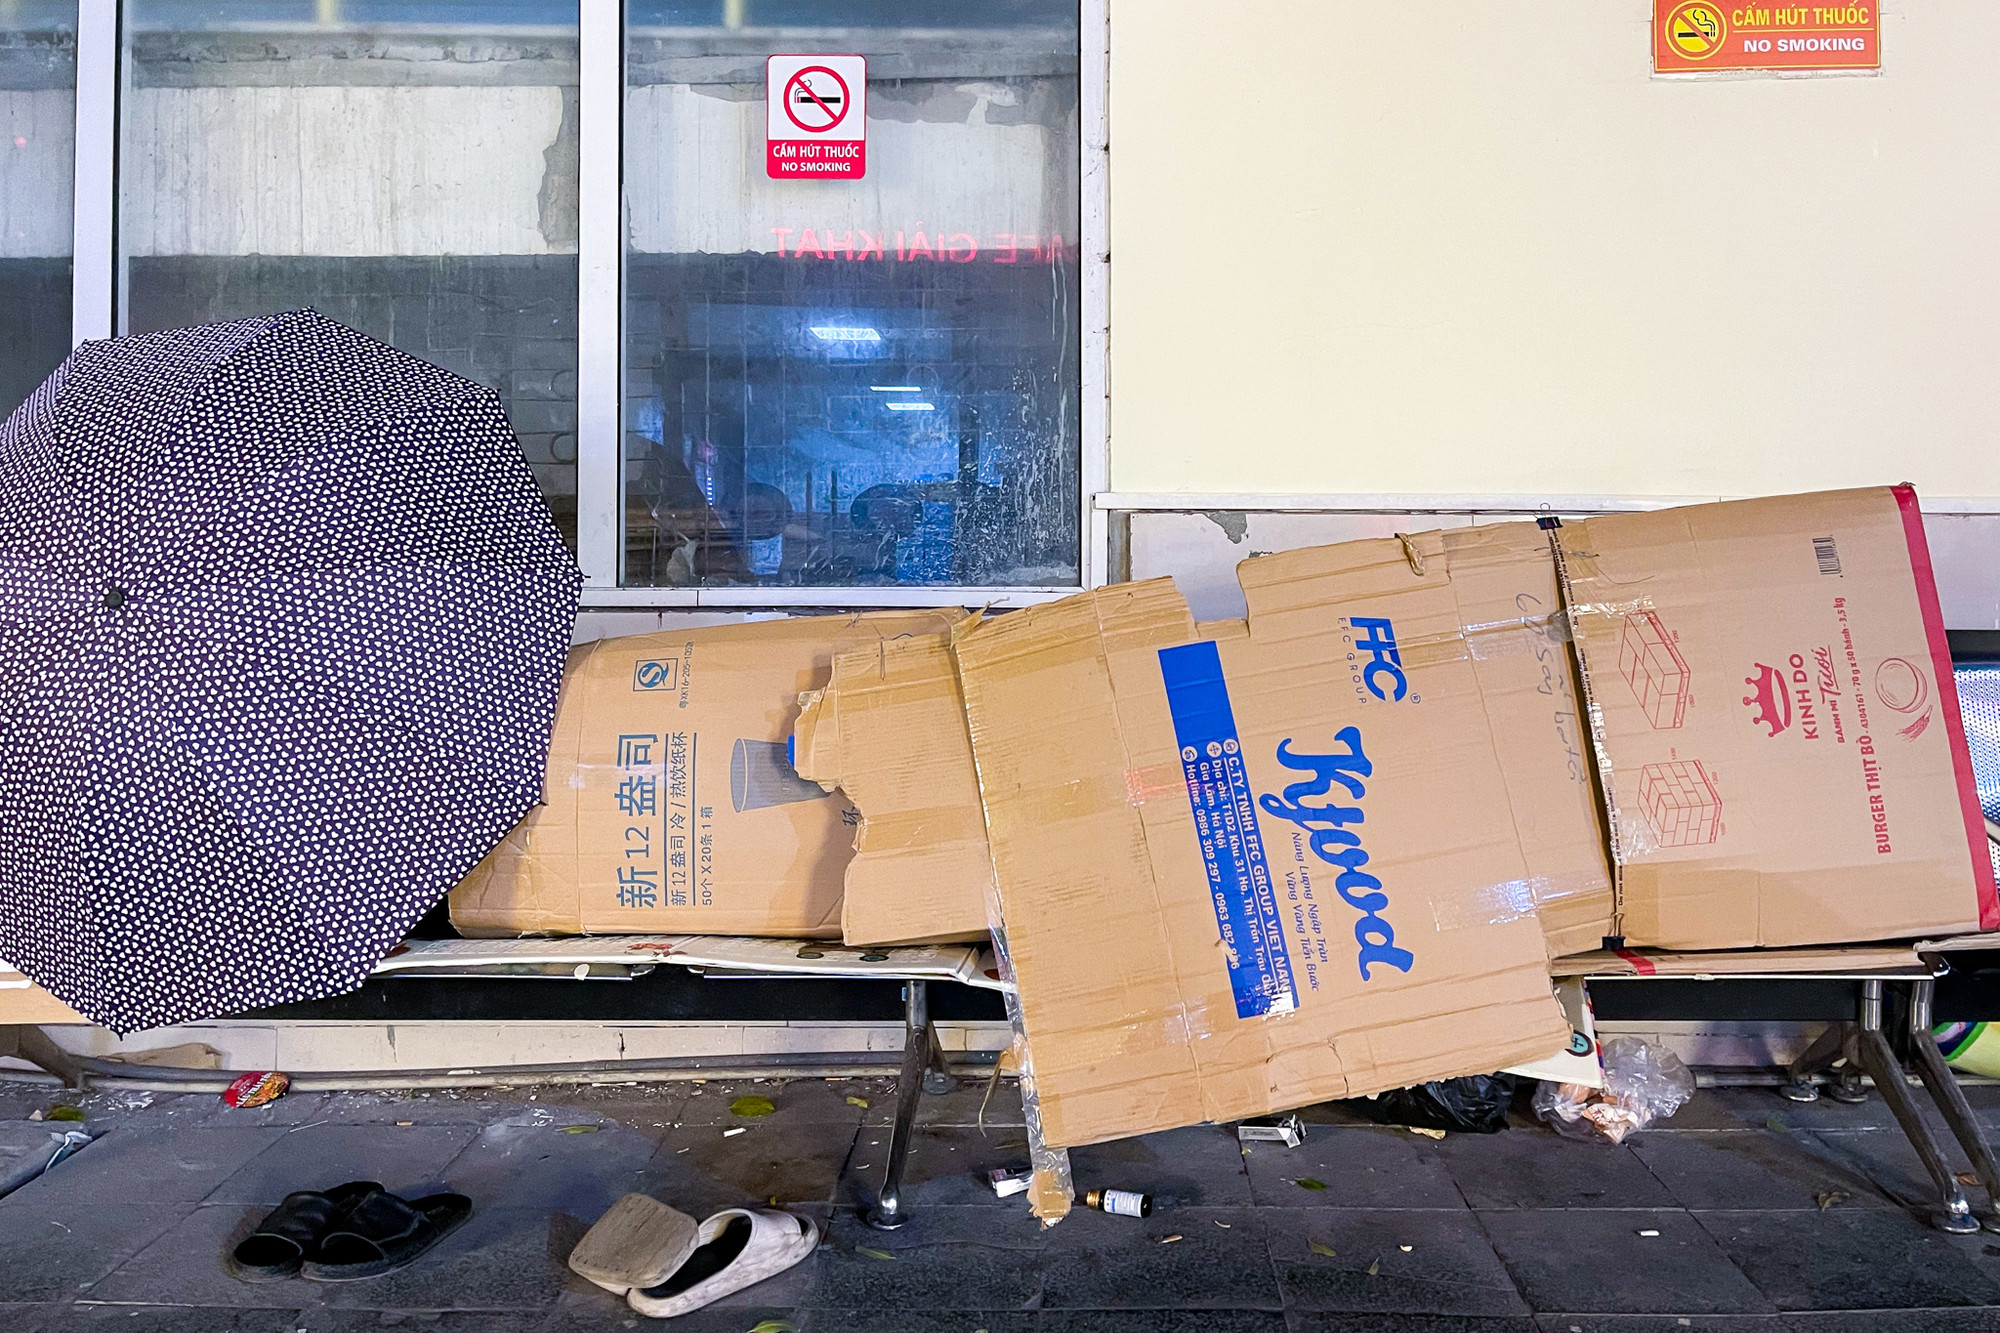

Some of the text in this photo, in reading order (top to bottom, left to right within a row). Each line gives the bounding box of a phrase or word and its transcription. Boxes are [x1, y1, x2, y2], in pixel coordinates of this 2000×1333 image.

[1732, 0, 1869, 27] CẤM HÚT THUỐC
[1744, 38, 1865, 53] NO SMOKING
[773, 142, 859, 158] CẤM HÚT THUỐC
[781, 161, 851, 172] NO SMOKING
[1833, 597, 1846, 609] kg
[1350, 616, 1408, 702] FFC
[1846, 651, 1856, 661] 50
[1346, 652, 1367, 704] GROUP
[1851, 676, 1861, 687] 70
[1789, 653, 1819, 740] KINH DO
[1856, 735, 1875, 755] BÒ
[1186, 764, 1201, 807] Hotline:
[1228, 756, 1245, 788] C.TY
[1863, 758, 1881, 792] THỊT
[1200, 762, 1210, 781] Gia
[1214, 829, 1228, 849] Nội
[1222, 802, 1236, 833] T1D2
[1236, 791, 1255, 832] TNHH
[1196, 809, 1210, 836] 0986
[1869, 794, 1892, 854] BURGER
[1203, 839, 1215, 860] 309
[1228, 834, 1240, 857] Khu
[1246, 834, 1262, 861] FFC
[1208, 862, 1221, 883] 297
[1234, 859, 1246, 873] 31
[1253, 864, 1274, 916] GROUP
[1215, 892, 1229, 921] 0963
[1243, 896, 1254, 916] Thị
[1248, 918, 1263, 943] Trấn
[1266, 919, 1283, 953] VIET
